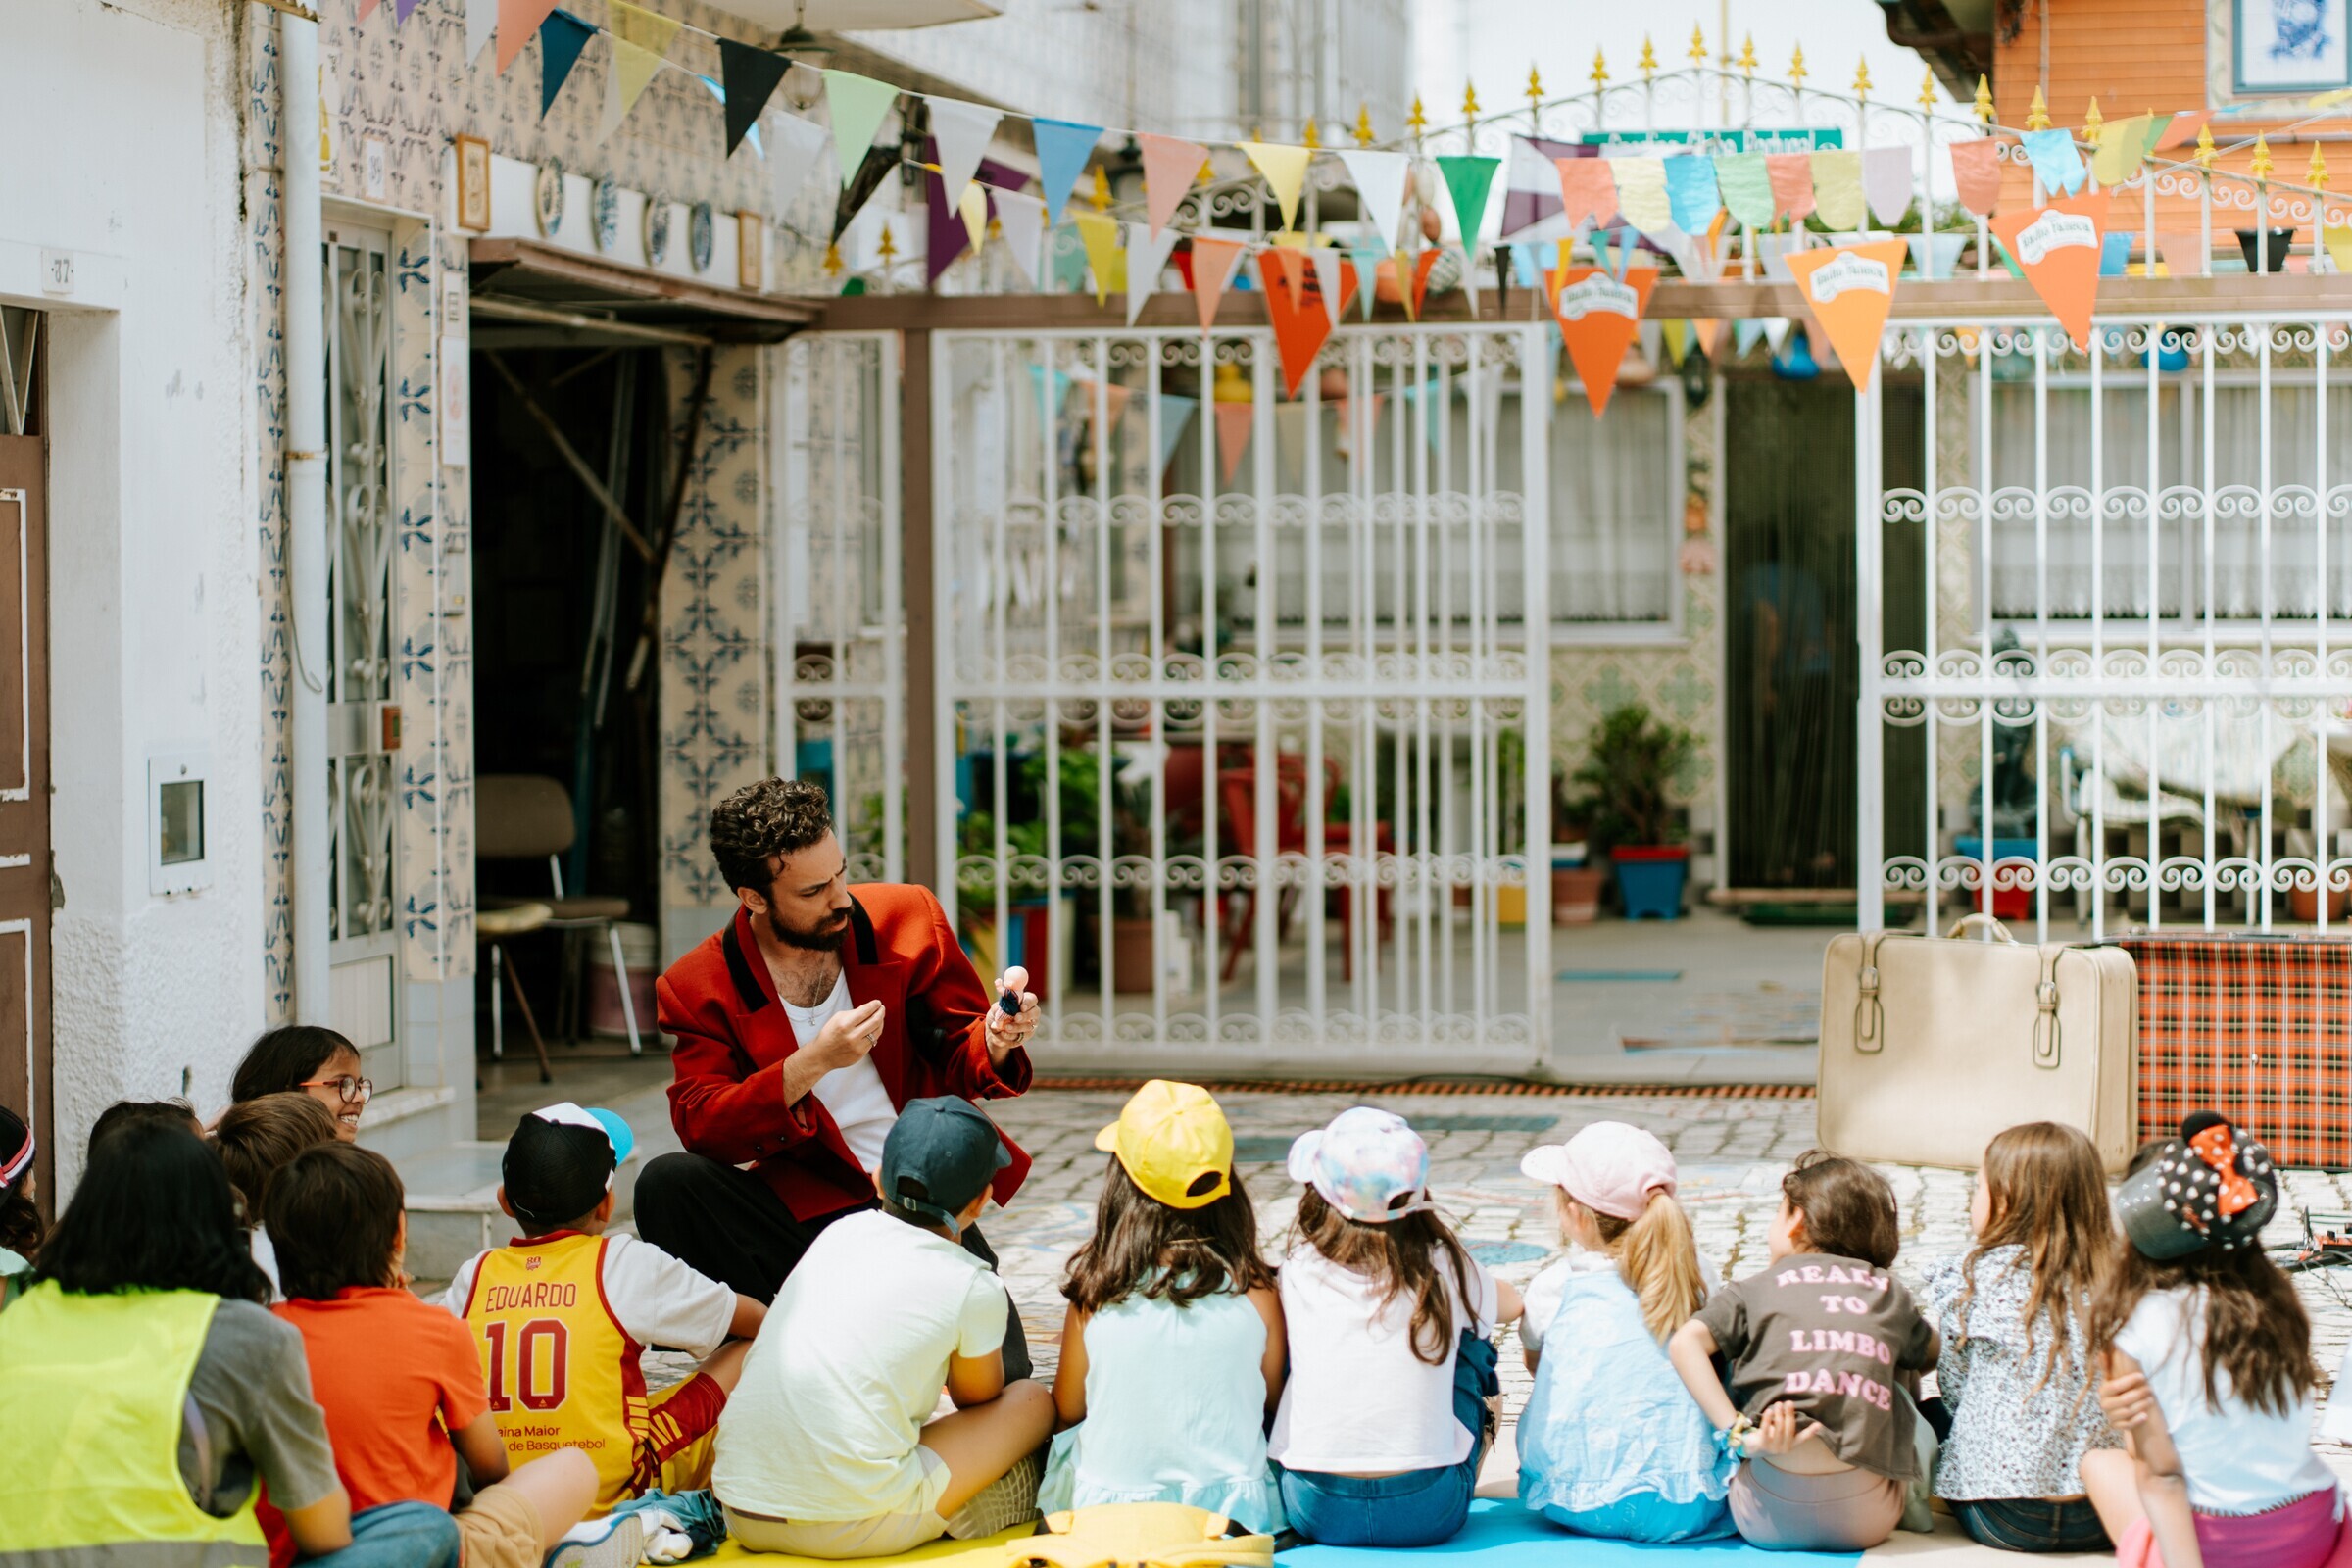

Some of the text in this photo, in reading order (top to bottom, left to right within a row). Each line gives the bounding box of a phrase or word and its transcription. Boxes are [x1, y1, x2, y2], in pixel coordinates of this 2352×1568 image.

[485, 1282, 576, 1313] EDUARDO
[1819, 1295, 1869, 1315] TO
[1789, 1329, 1891, 1365] LIMBO
[485, 1317, 569, 1412] 10
[1785, 1368, 1891, 1411] DANCE
[508, 1440, 524, 1451] de
[524, 1425, 561, 1437] Maior
